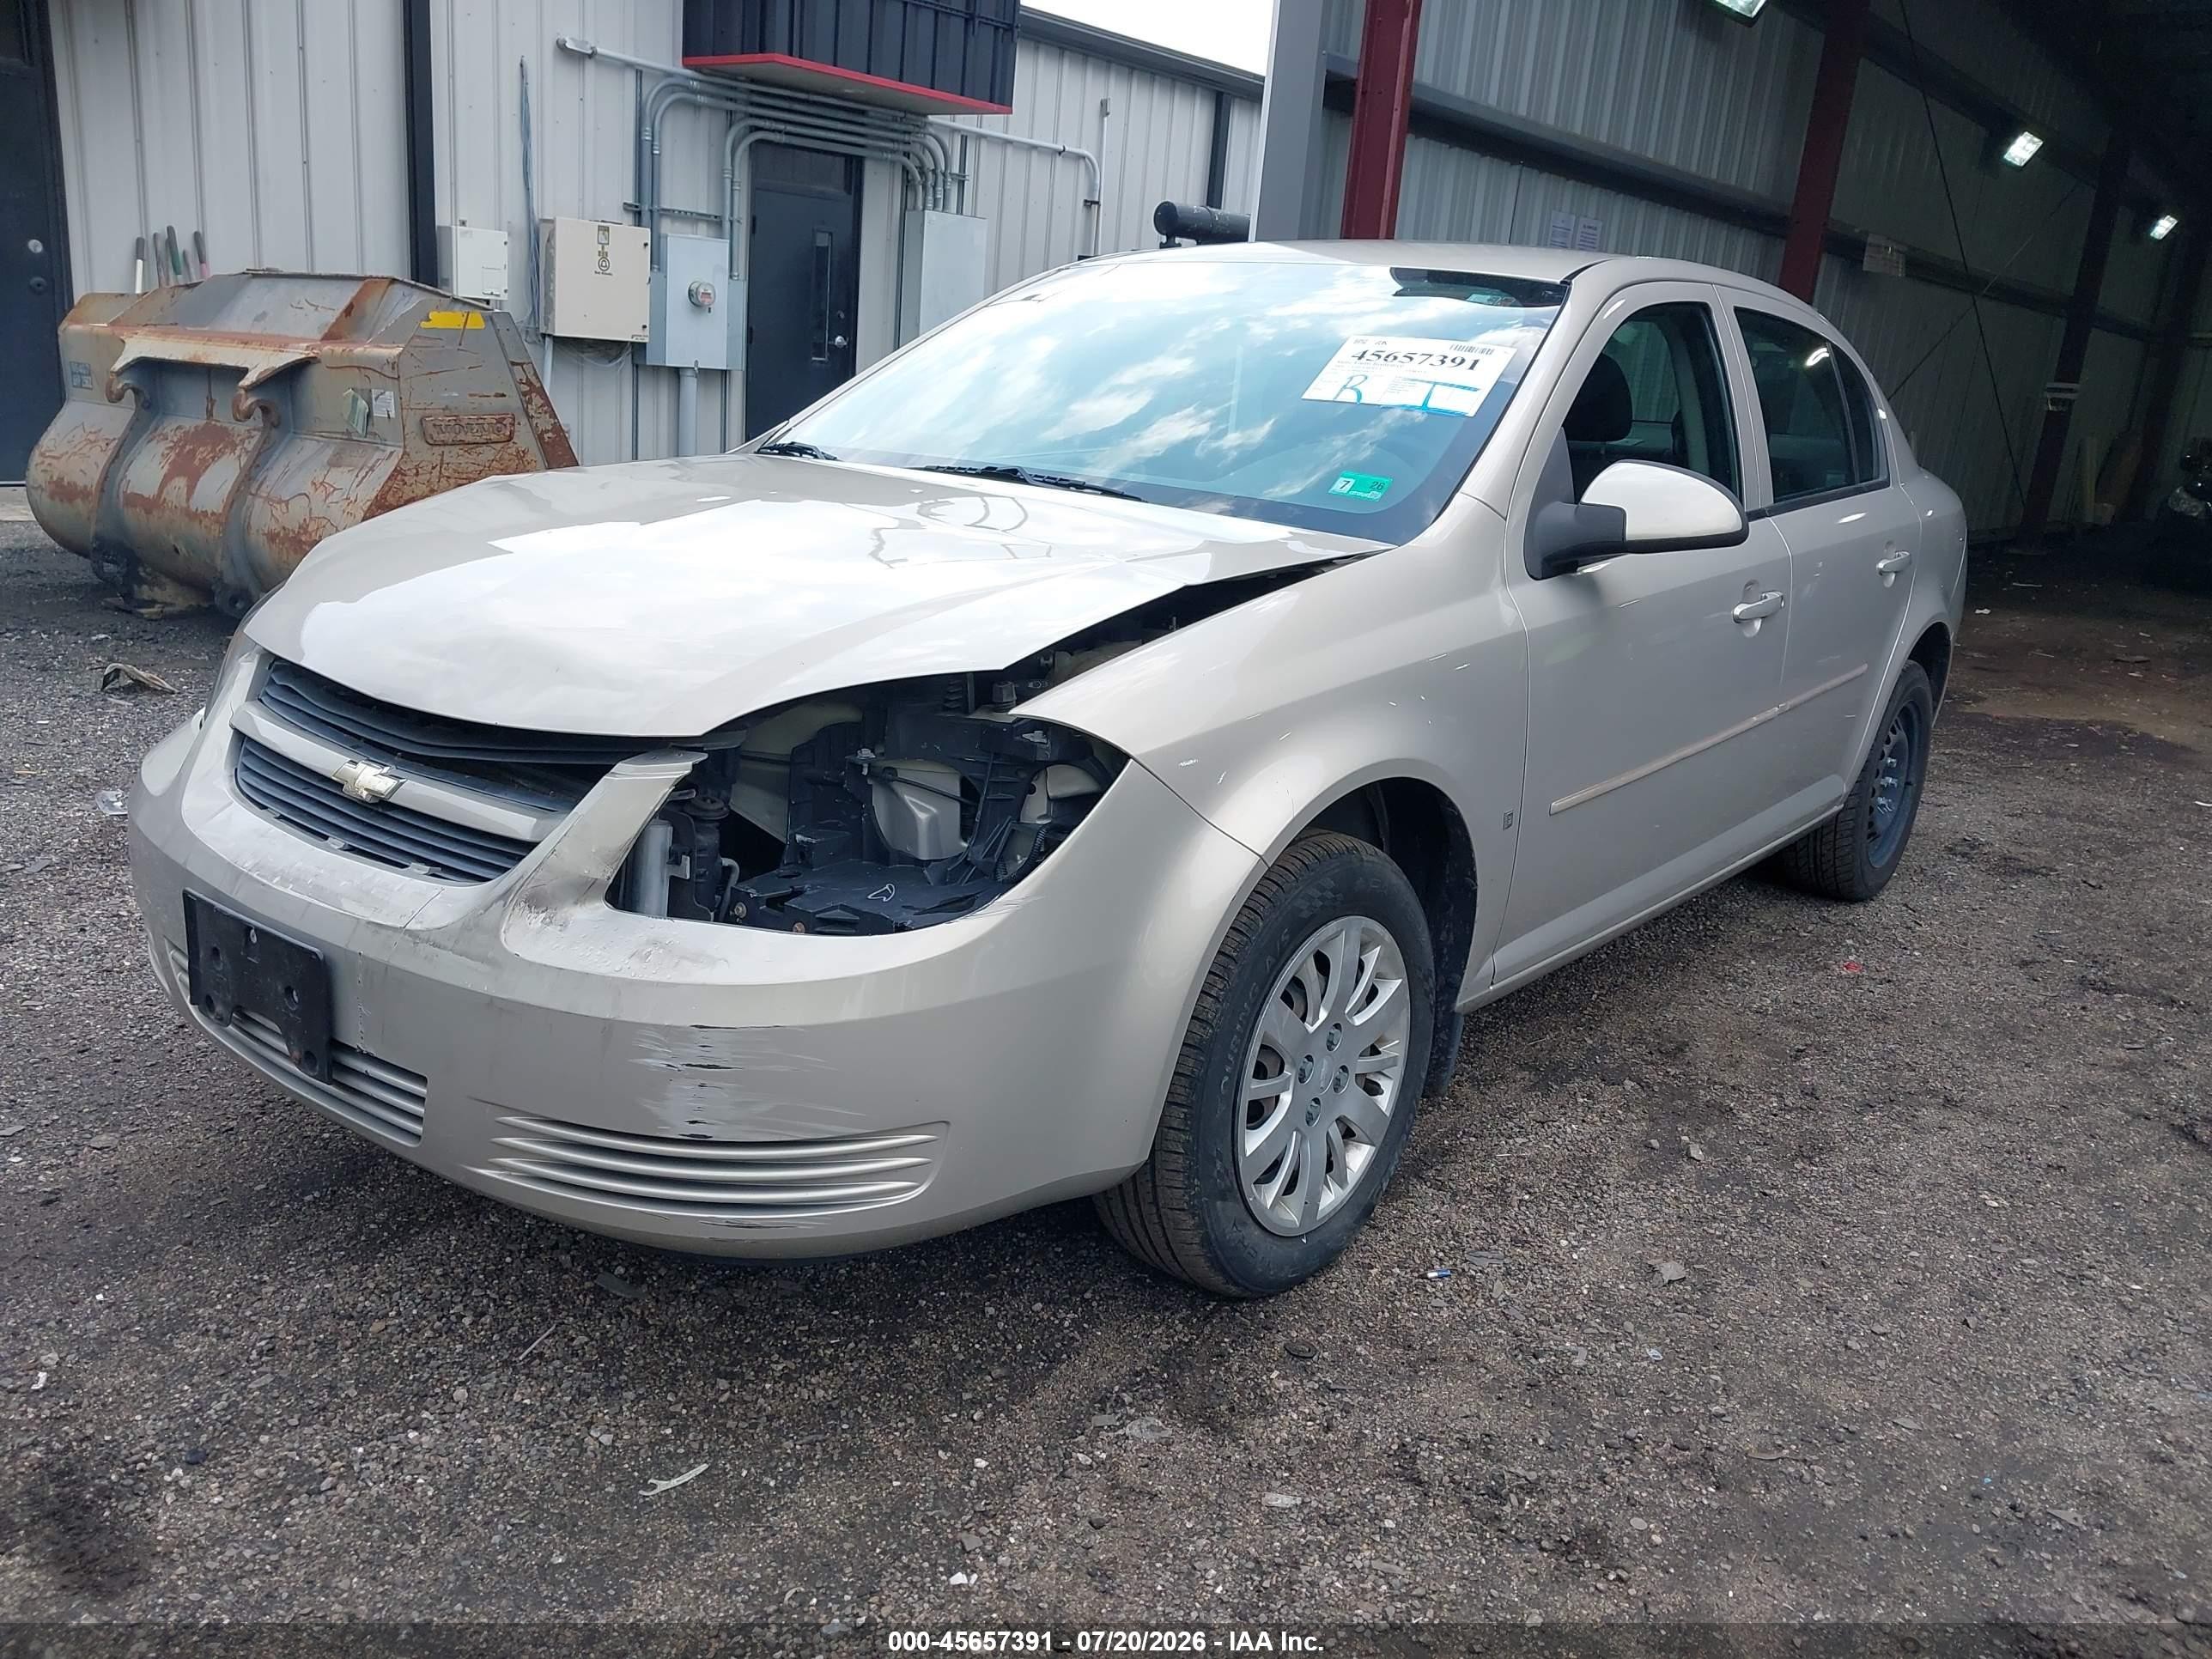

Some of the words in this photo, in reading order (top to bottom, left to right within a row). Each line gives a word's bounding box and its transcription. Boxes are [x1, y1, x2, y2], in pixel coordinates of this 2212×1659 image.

[1351, 349, 1481, 371] 45657391
[1340, 480, 1351, 489] 7
[1370, 481, 1385, 490] 26
